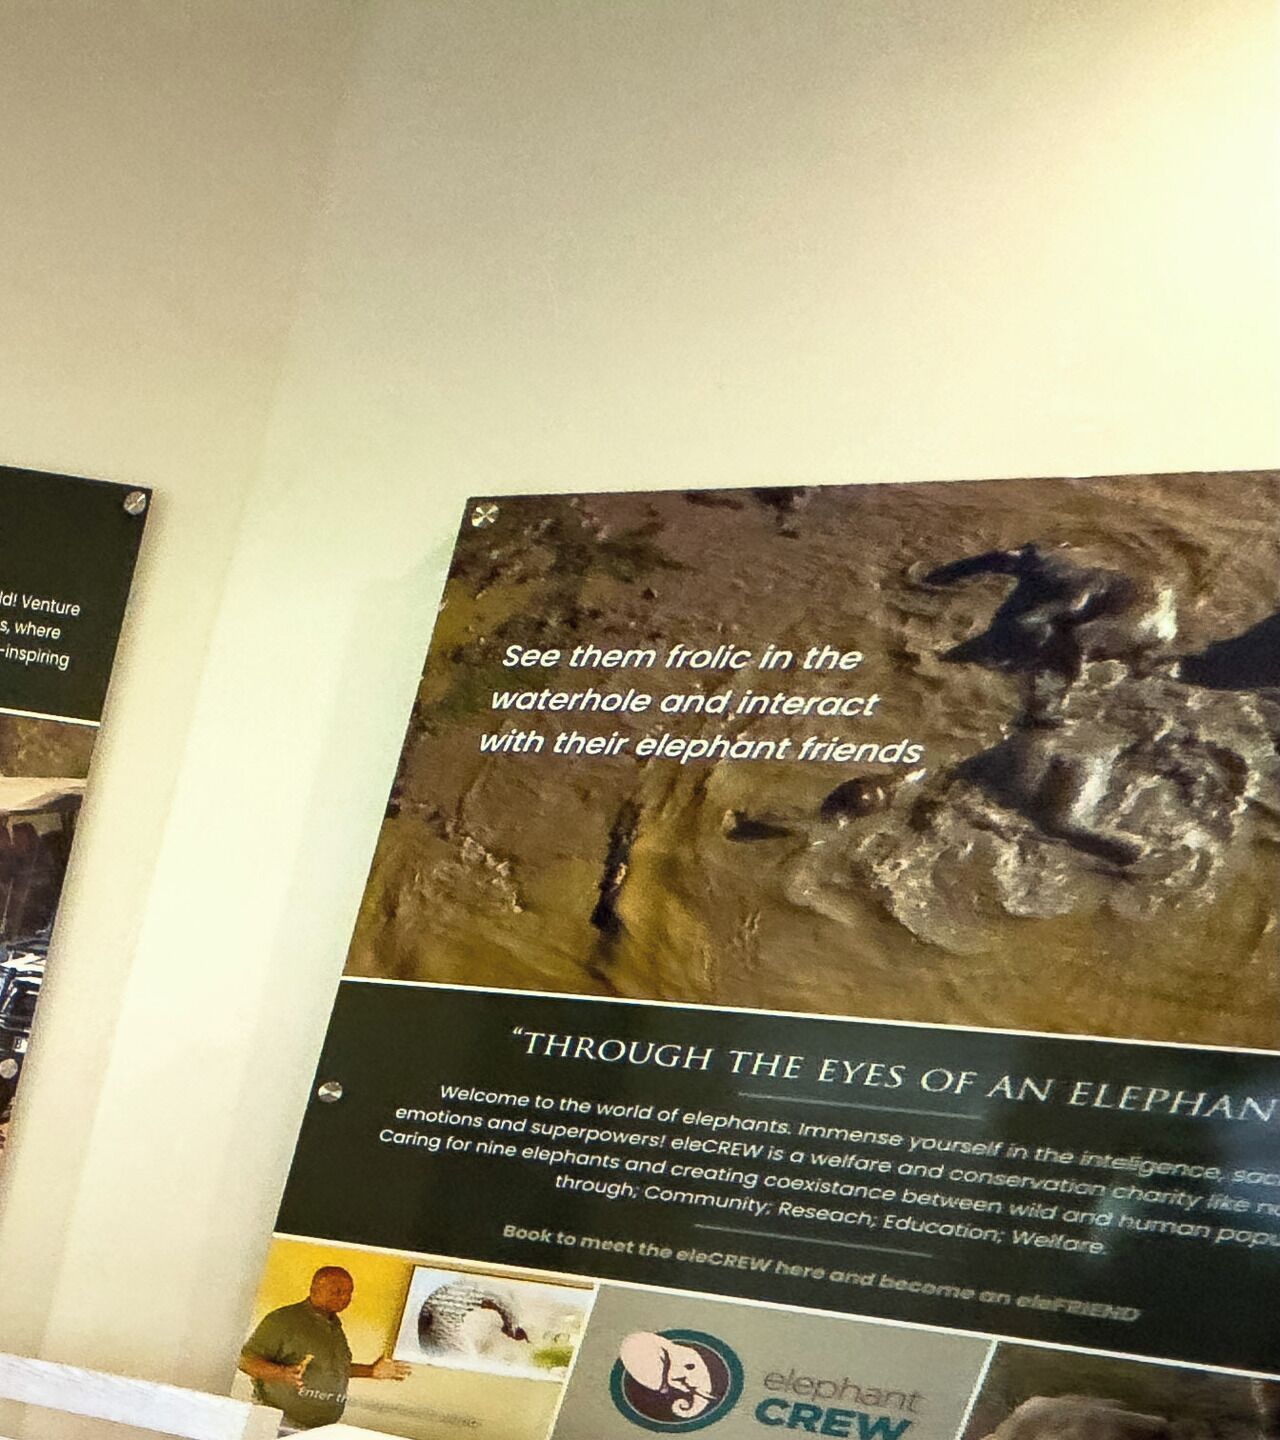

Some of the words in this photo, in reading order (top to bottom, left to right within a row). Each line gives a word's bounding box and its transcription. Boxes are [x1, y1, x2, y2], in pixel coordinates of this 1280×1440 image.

[22, 594, 81, 616] Venture
[14, 621, 61, 639] where
[502, 644, 560, 667] See
[568, 644, 656, 667] them
[664, 644, 750, 668] frolic
[758, 644, 793, 669] in
[802, 645, 864, 670] the
[491, 688, 652, 711] waterhole
[661, 689, 733, 714] and
[736, 690, 880, 716] interact
[480, 729, 544, 752] with
[553, 731, 630, 754] their
[635, 730, 792, 764] elephant
[798, 736, 925, 764] friends
[729, 1050, 804, 1078] THE
[817, 1059, 906, 1088] EYES
[920, 1068, 978, 1094] OF
[985, 1075, 1054, 1101] AN
[1067, 1082, 1279, 1120] ELEPHAN
[764, 1368, 926, 1413] elephant
